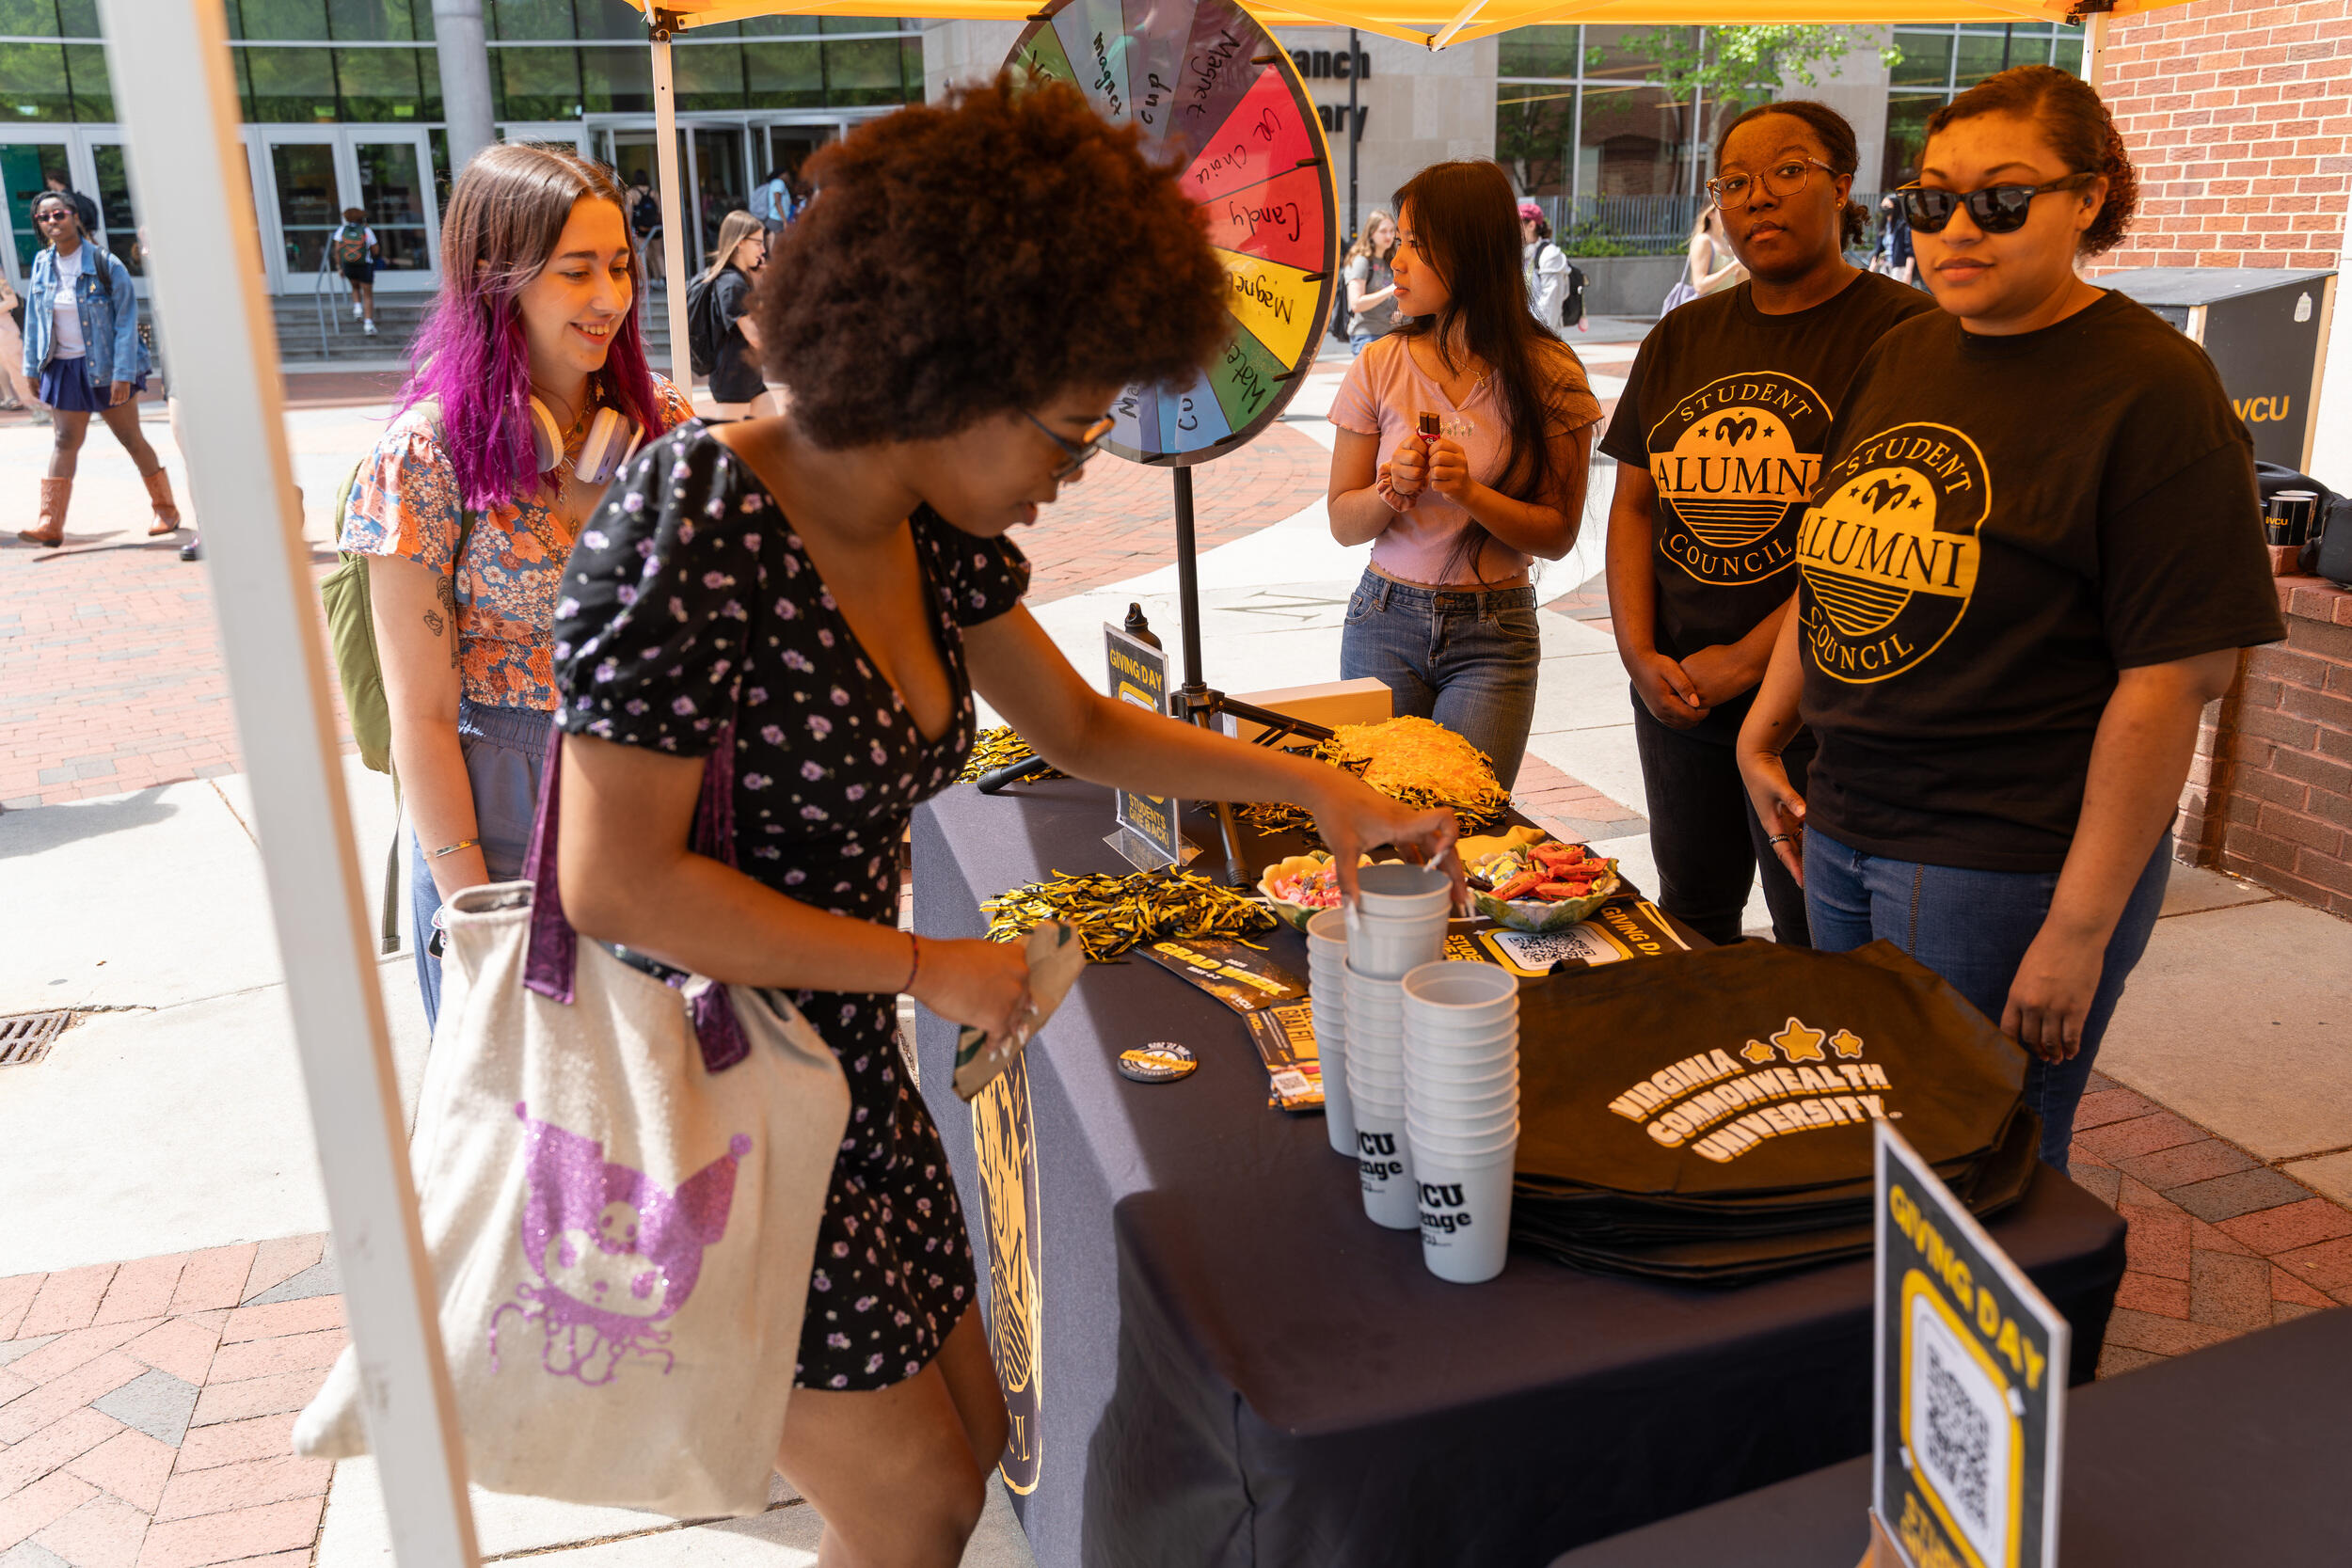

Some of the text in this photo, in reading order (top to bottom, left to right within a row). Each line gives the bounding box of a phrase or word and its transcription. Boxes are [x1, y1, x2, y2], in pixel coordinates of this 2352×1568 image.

[1186, 29, 1241, 119] Magnet
[1289, 40, 1370, 79] anch
[1229, 200, 1300, 242] Candy
[1225, 340, 1266, 414] Wate
[1679, 383, 1813, 422] STUDENT
[2233, 395, 2290, 422] VCU
[1658, 456, 1822, 497] ALUMN
[1845, 436, 1973, 497] STUDENT
[2269, 517, 2289, 526] VCU
[1669, 532, 1793, 577] COUNCIL
[1797, 513, 1967, 590] ALUMNI
[1811, 605, 1915, 671] COUNCIL
[1110, 649, 1163, 692] GIVING DAY
[1129, 793, 1167, 830] STUDENTS
[1144, 817, 1169, 850] BACK!
[1600, 907, 1650, 942] GIVING
[1152, 942, 1292, 996] GRAD WEEK
[1608, 1048, 1746, 1123] VIRGINIA
[1646, 1063, 1893, 1148] COMMONWEALTH
[1355, 1128, 1396, 1156] CU
[1691, 1095, 1885, 1164] UNIVERSITY
[1415, 1180, 1464, 1208] CU
[1889, 1183, 2048, 1392] GIVING DAY
